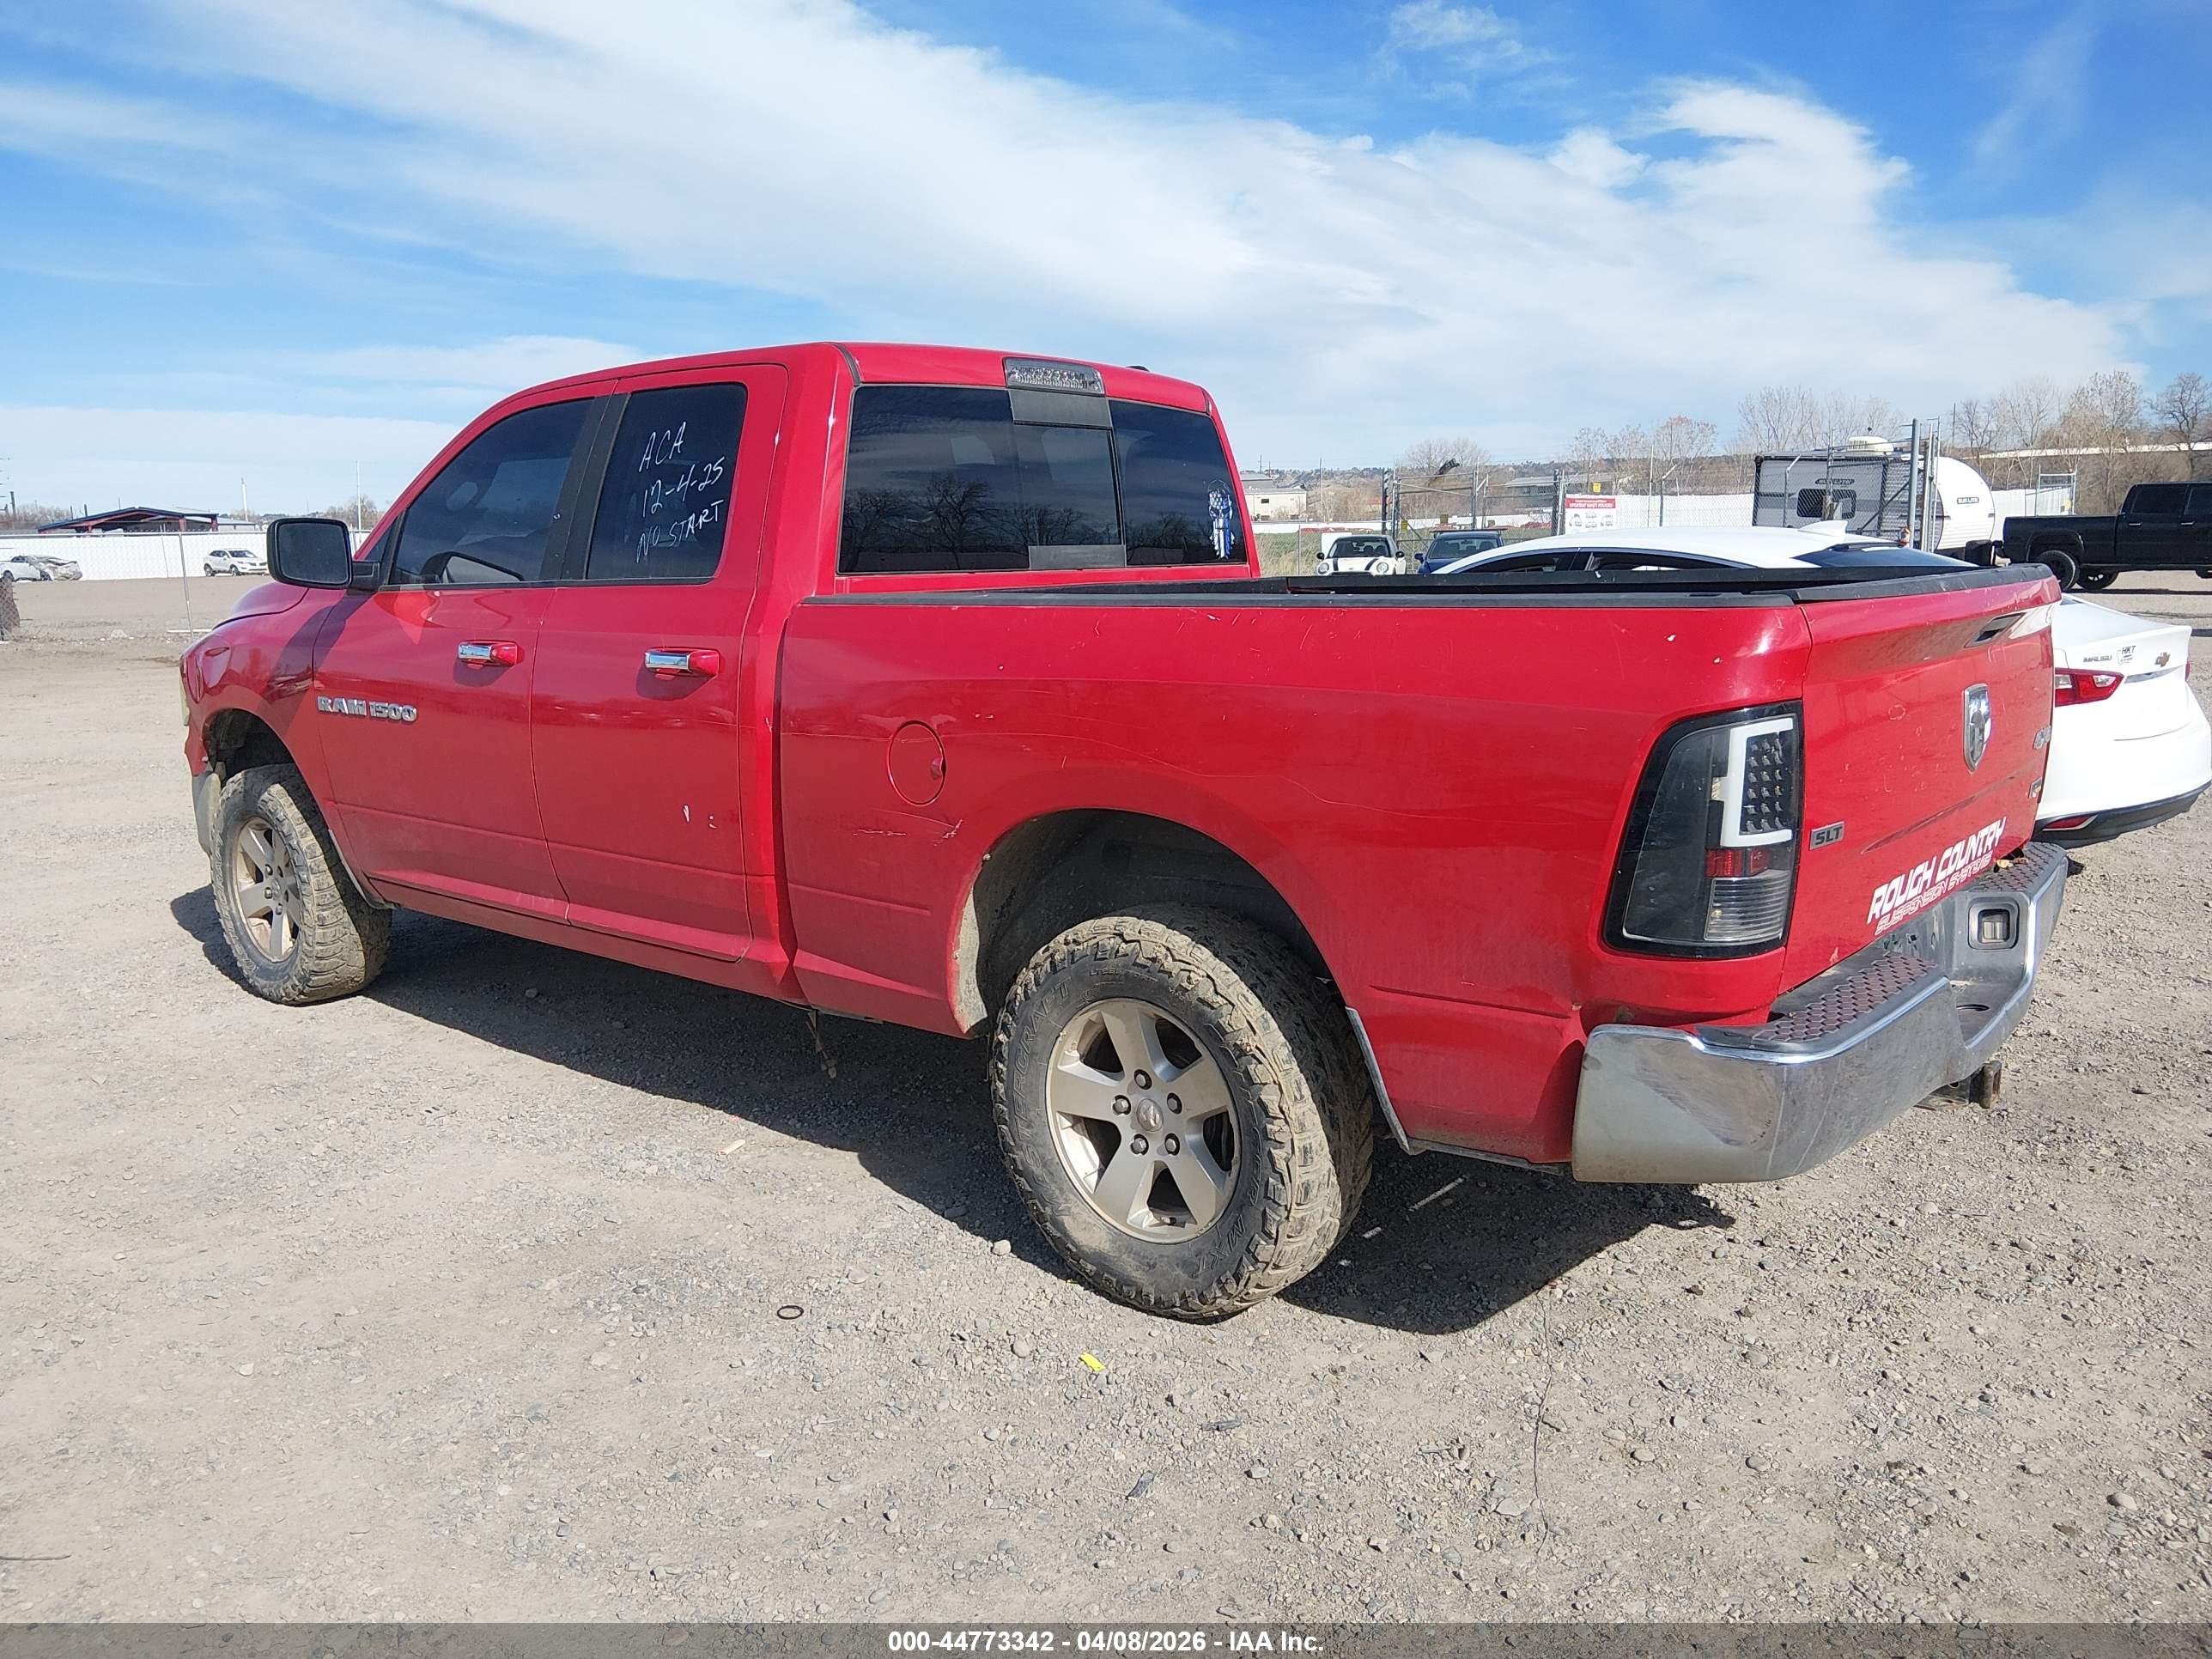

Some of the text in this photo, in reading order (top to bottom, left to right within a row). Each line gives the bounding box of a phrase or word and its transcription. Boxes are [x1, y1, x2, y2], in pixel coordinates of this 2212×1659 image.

[638, 421, 687, 472] ACA
[642, 456, 726, 518] 12-4-25
[635, 499, 725, 564] NO START
[317, 696, 417, 722] RAM 1500
[1814, 825, 1843, 847] SLT
[1866, 815, 2007, 925] ROUGH COUNTRY
